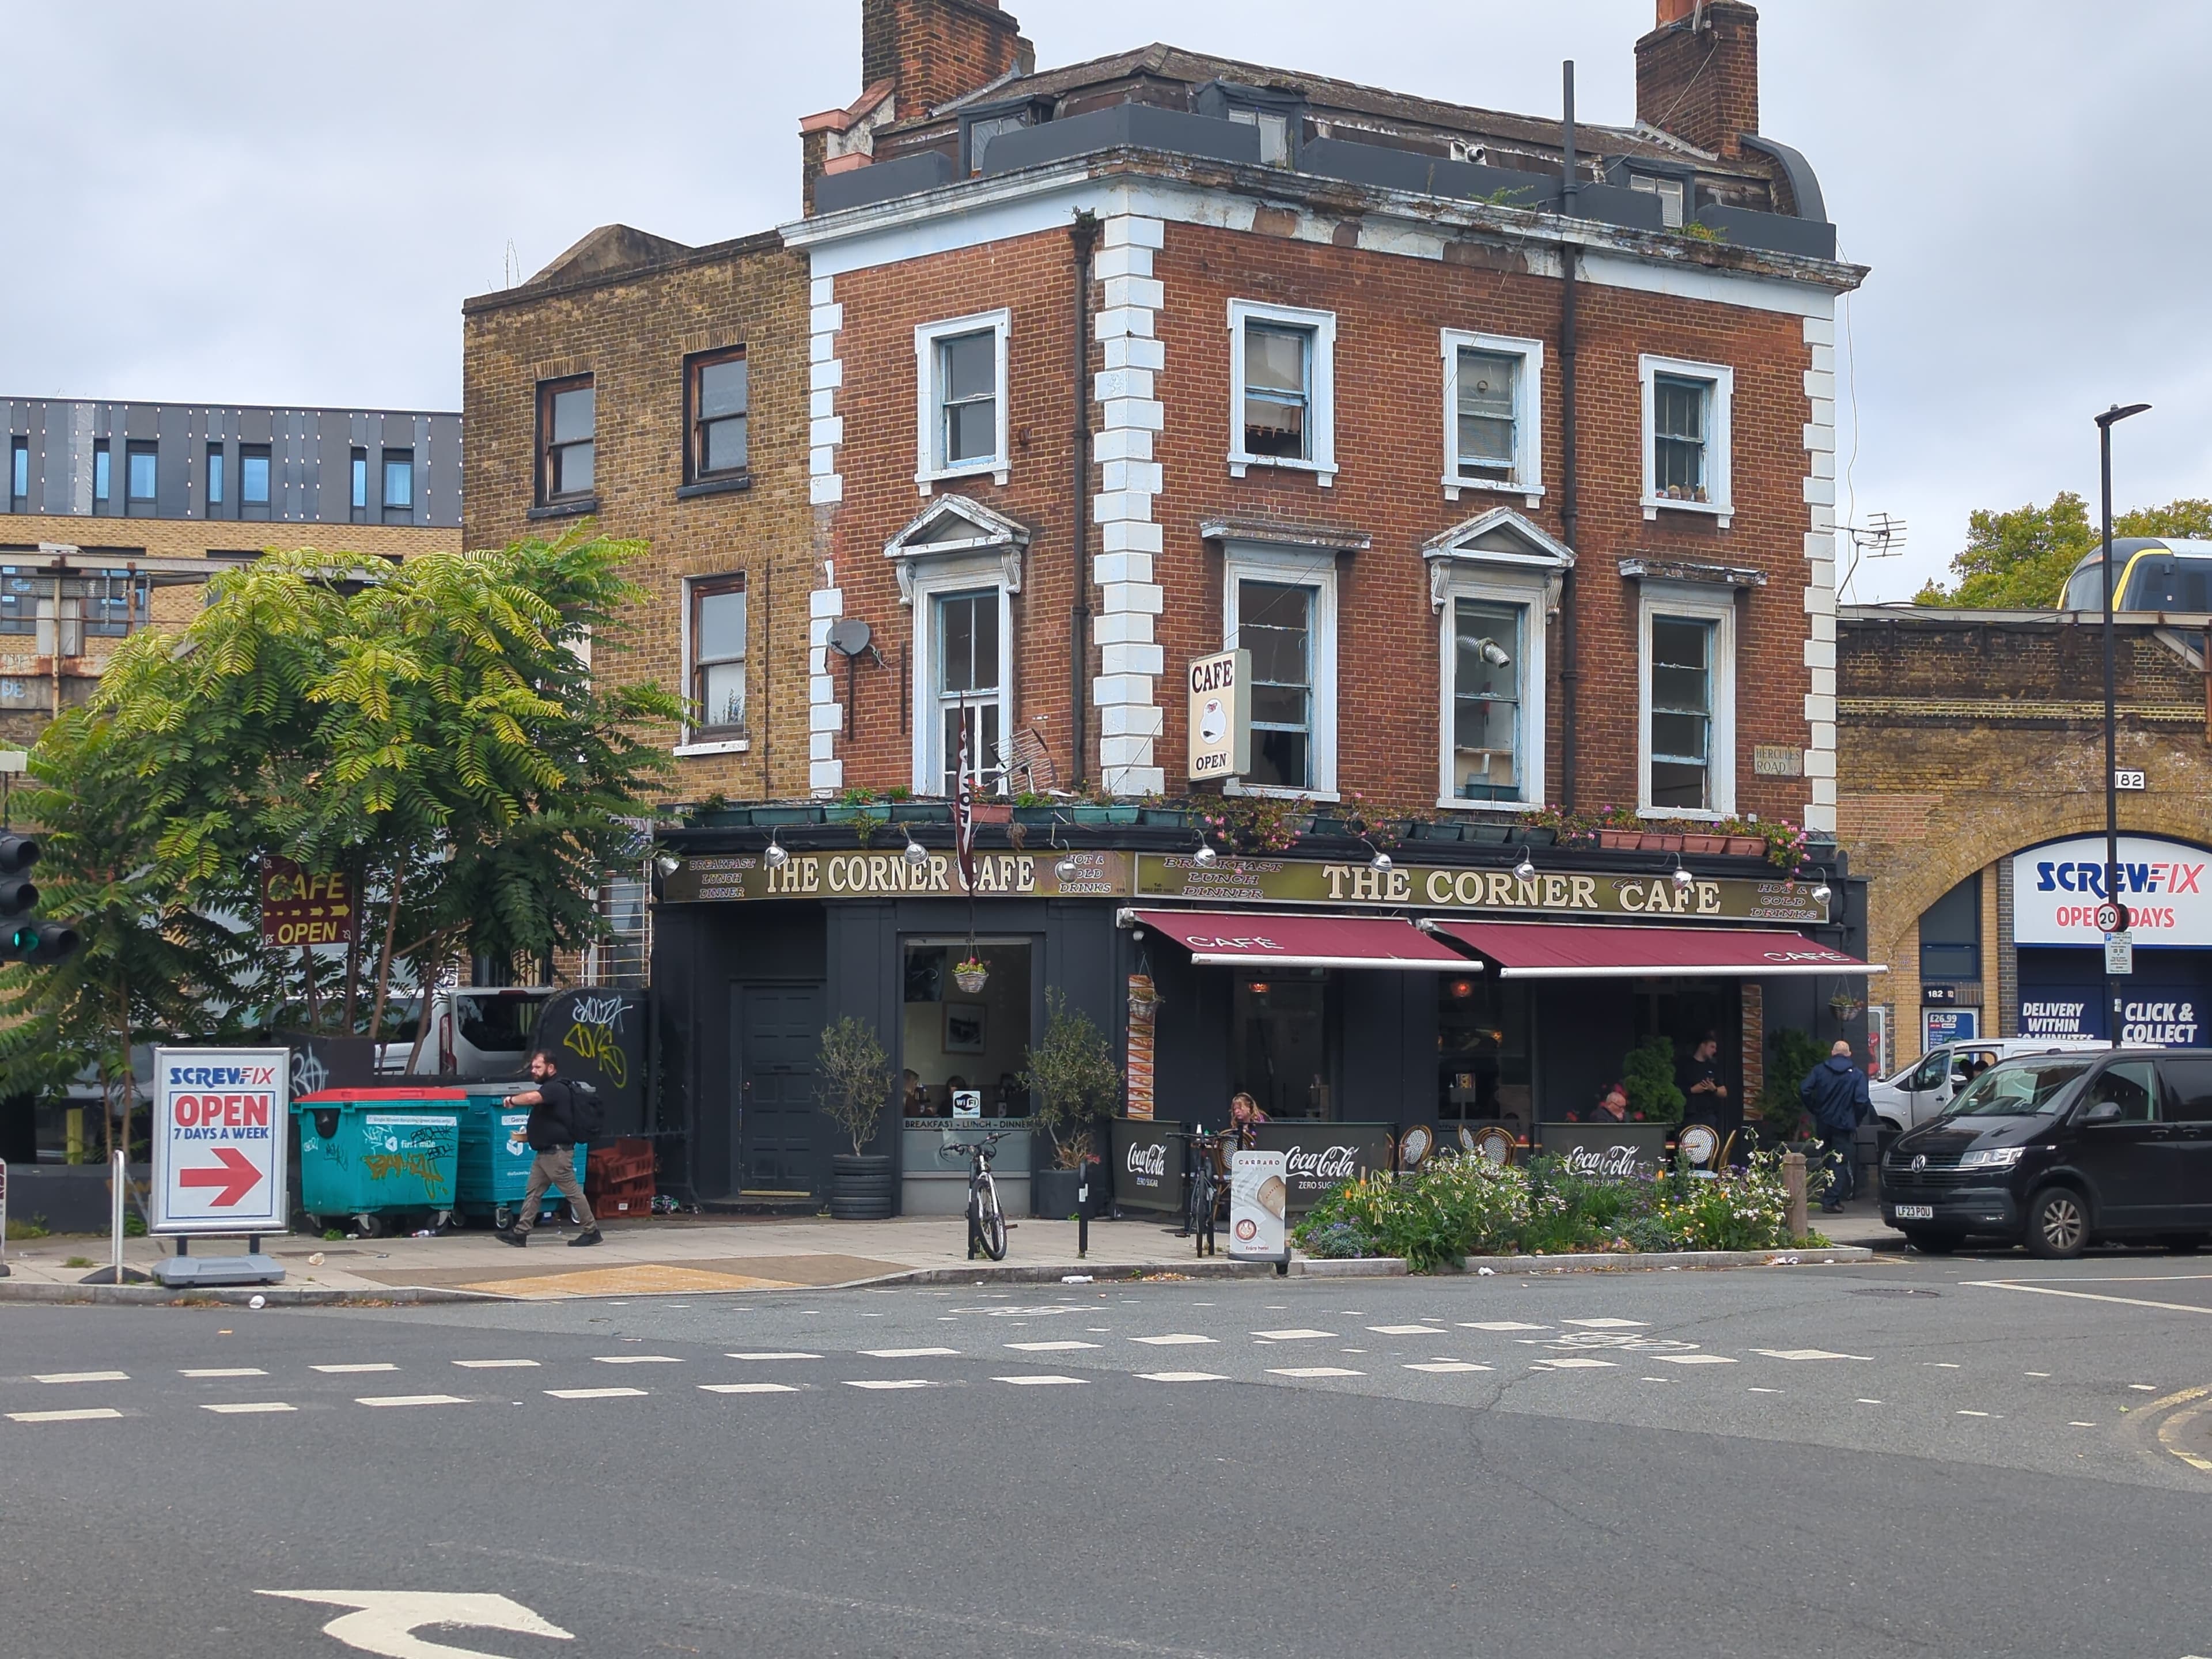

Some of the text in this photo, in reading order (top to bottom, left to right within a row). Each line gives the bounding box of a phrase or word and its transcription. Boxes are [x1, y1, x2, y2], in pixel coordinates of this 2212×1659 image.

[1192, 660, 1233, 693] CAFE
[1756, 748, 1800, 760] HERCULES
[1196, 753, 1227, 770] OPEN
[1757, 761, 1786, 772] ROAD
[2116, 774, 2142, 787] 182
[690, 858, 756, 871] BREAKFAST
[1096, 855, 1104, 864] &
[1164, 858, 1283, 872] BREKFAST
[702, 873, 742, 884] LUNCH
[764, 855, 1036, 893] THE CORNER CAFE
[1076, 869, 1103, 878] OLD
[1188, 873, 1259, 884] LUNCH
[268, 872, 344, 902] CAFE
[2037, 862, 2205, 899] SCREWFIX
[699, 887, 745, 899] DINNER
[1058, 883, 1111, 893] DRINKS
[1181, 887, 1264, 899] DINNER
[1322, 865, 1721, 914] THE CORNER CAFE
[1758, 883, 1793, 893] HOT
[1761, 896, 1806, 906] COLD
[1750, 908, 1817, 919] DRINKS
[2099, 911, 2116, 925] 20
[2128, 908, 2175, 927] DAYS
[278, 922, 337, 944] OPEN
[1186, 936, 1285, 949] CAFE
[1764, 952, 1850, 961] CAFE
[2022, 1002, 2085, 1017] DELIVERY
[2125, 1003, 2176, 1021] CLICK
[2179, 1003, 2194, 1021] &
[1929, 1014, 1957, 1022] £26.99
[2028, 1018, 2080, 1032] WITHIN
[2122, 1024, 2198, 1043] COLLECT
[170, 1067, 276, 1088] SCREWFIX
[175, 1095, 267, 1127] OPEN
[175, 1127, 269, 1139] 7 DAYS A WEEK
[1127, 1142, 1166, 1176] Coca-Cola
[1286, 1146, 1359, 1177] Coca-Cola
[1565, 1146, 1640, 1175] CocaCola
[1299, 1181, 1333, 1190] ZERO SUG
[1898, 1206, 1915, 1216] LF23
